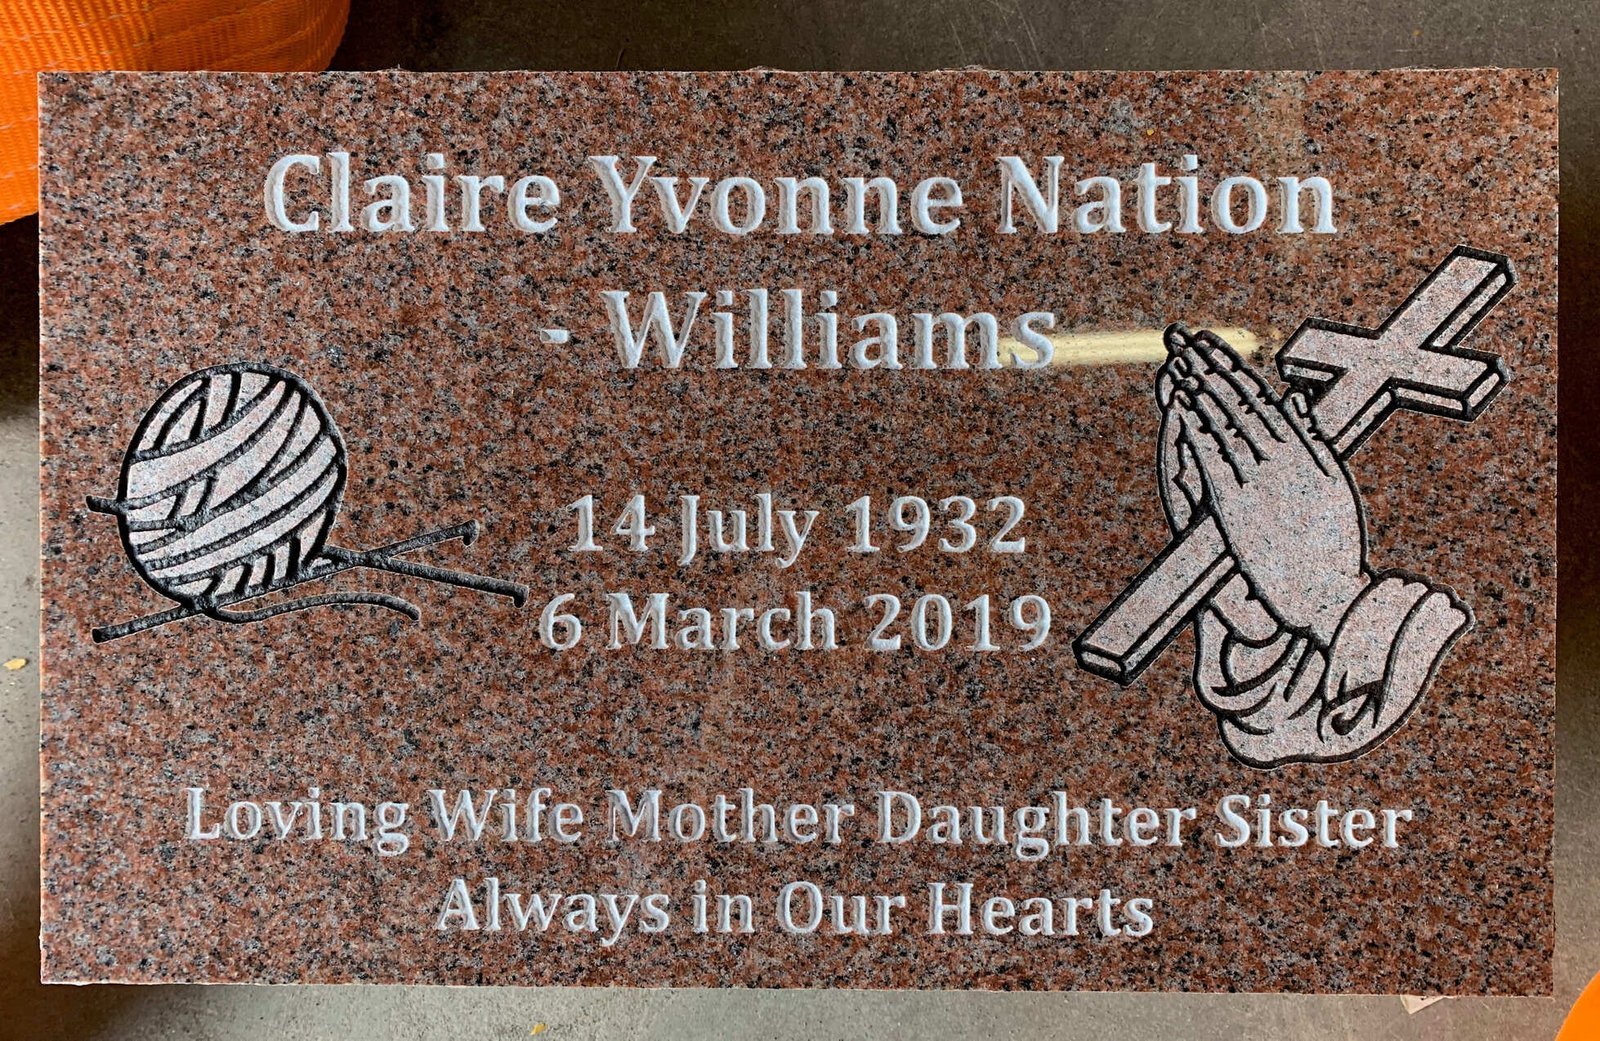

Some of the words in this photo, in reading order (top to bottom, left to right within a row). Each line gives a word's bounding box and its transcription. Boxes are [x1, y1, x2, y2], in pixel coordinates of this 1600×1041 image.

[263, 151, 563, 236] Claire
[590, 151, 964, 238] Yvonne
[996, 153, 1338, 237] Nation
[601, 288, 1056, 372] Williams
[568, 495, 656, 554] 14
[674, 494, 820, 568] July
[845, 495, 1028, 554] 1932
[538, 593, 583, 651] 6
[607, 590, 839, 653] March
[864, 595, 1052, 653] 2019
[186, 784, 410, 855] Loving
[430, 784, 585, 845] Wife
[606, 787, 855, 846] Mother
[877, 790, 1198, 862] Daughter
[1214, 795, 1413, 851] Sister
[437, 878, 670, 948] Always
[692, 880, 755, 935] in
[776, 882, 906, 937] Our
[927, 884, 1154, 939] Hearts
